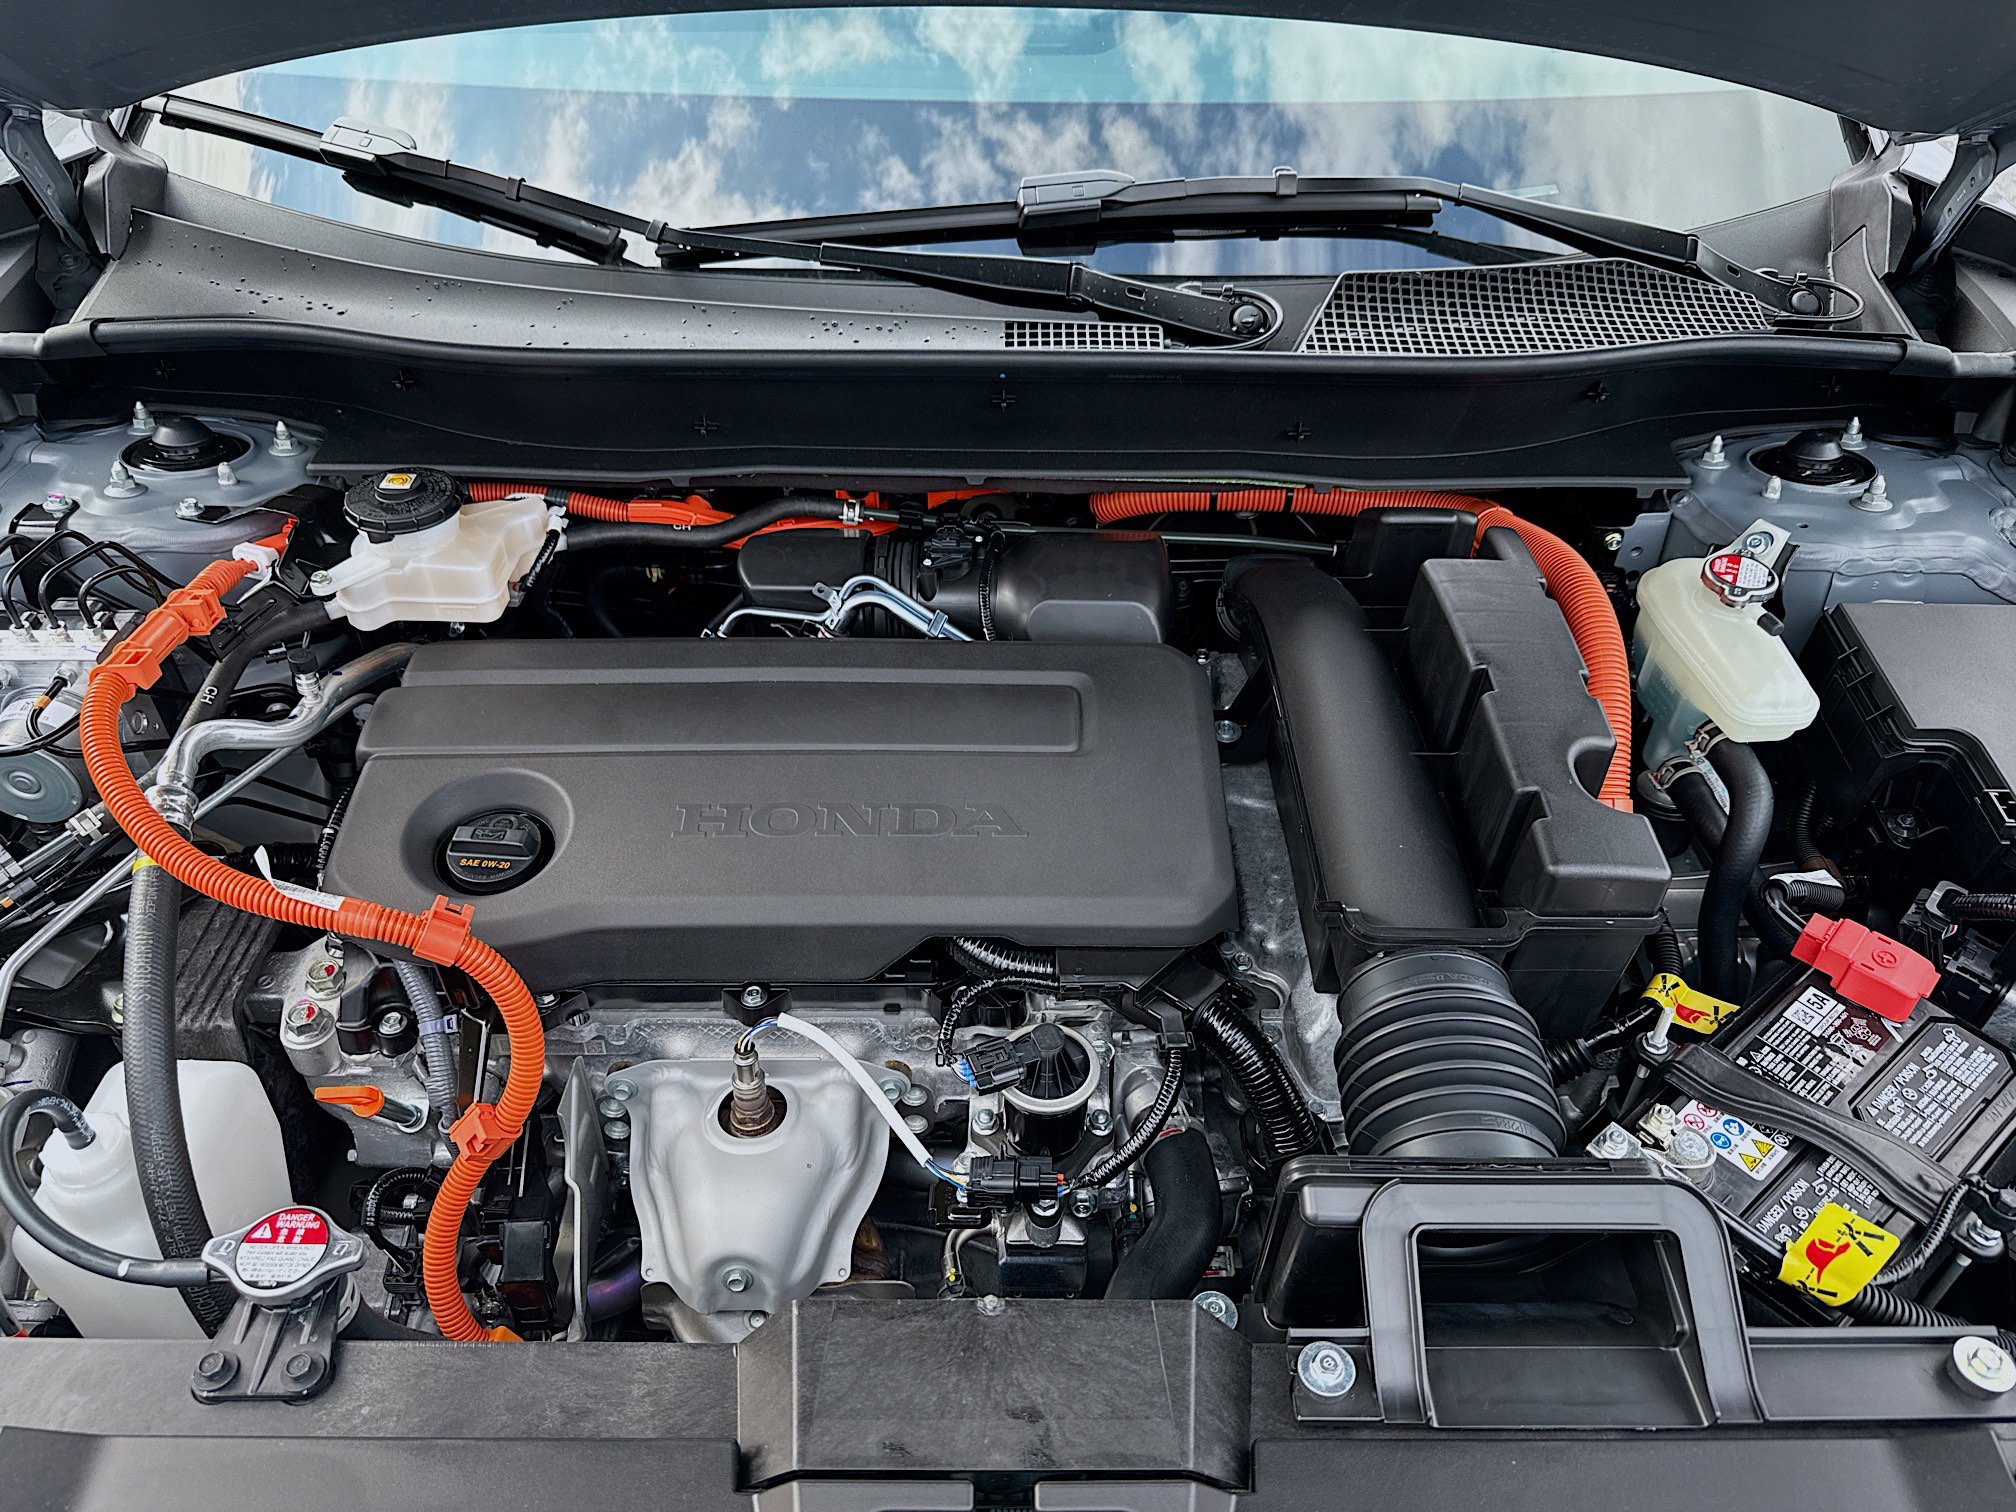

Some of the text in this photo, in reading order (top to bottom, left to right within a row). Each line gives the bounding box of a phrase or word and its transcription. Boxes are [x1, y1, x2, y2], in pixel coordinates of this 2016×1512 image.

[200, 686, 218, 705] CH
[671, 802, 1029, 838] HONDA
[460, 858, 511, 869] SAE 0W-20
[133, 929, 154, 988] NICHIRIN
[1807, 993, 1830, 1010] 5A
[276, 1221, 320, 1229] WARNUNG
[280, 1213, 315, 1221] DANGER
